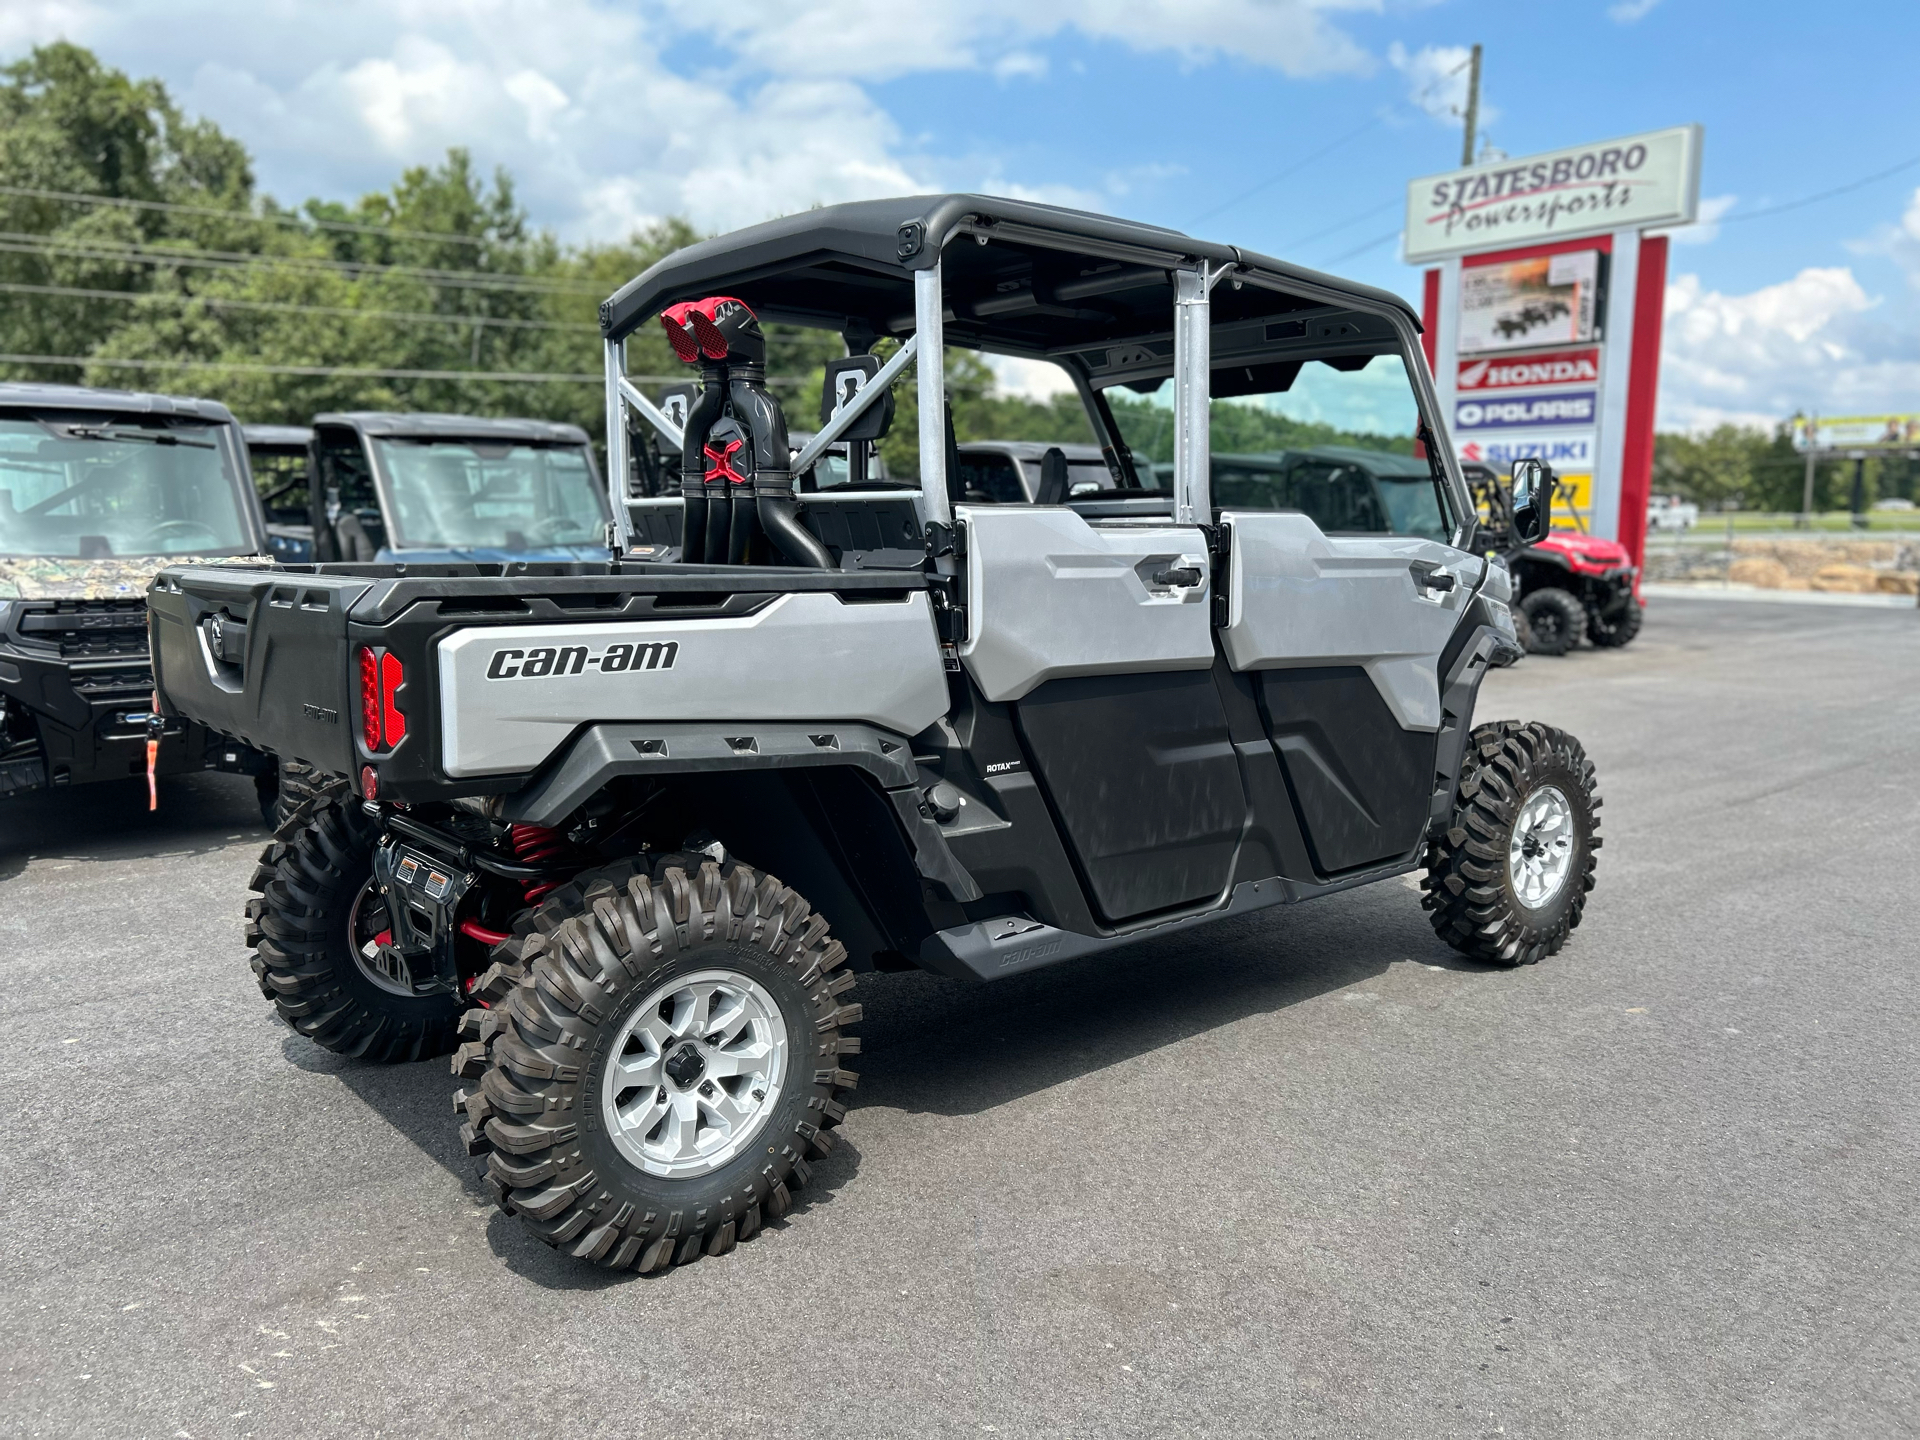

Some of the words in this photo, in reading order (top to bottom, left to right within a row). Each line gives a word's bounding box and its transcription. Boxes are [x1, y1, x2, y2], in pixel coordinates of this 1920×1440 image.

[1431, 144, 1648, 208] STATESBORO
[1444, 180, 1634, 237] Powersports
[1486, 359, 1597, 386] HONDA
[1484, 398, 1592, 422] POLARIS
[1487, 440, 1588, 464] SUZUKI
[486, 641, 680, 680] can-am
[986, 762, 1010, 773] ROTAX
[582, 1033, 605, 1133] SWAMP
[608, 958, 677, 1030] FORCE
